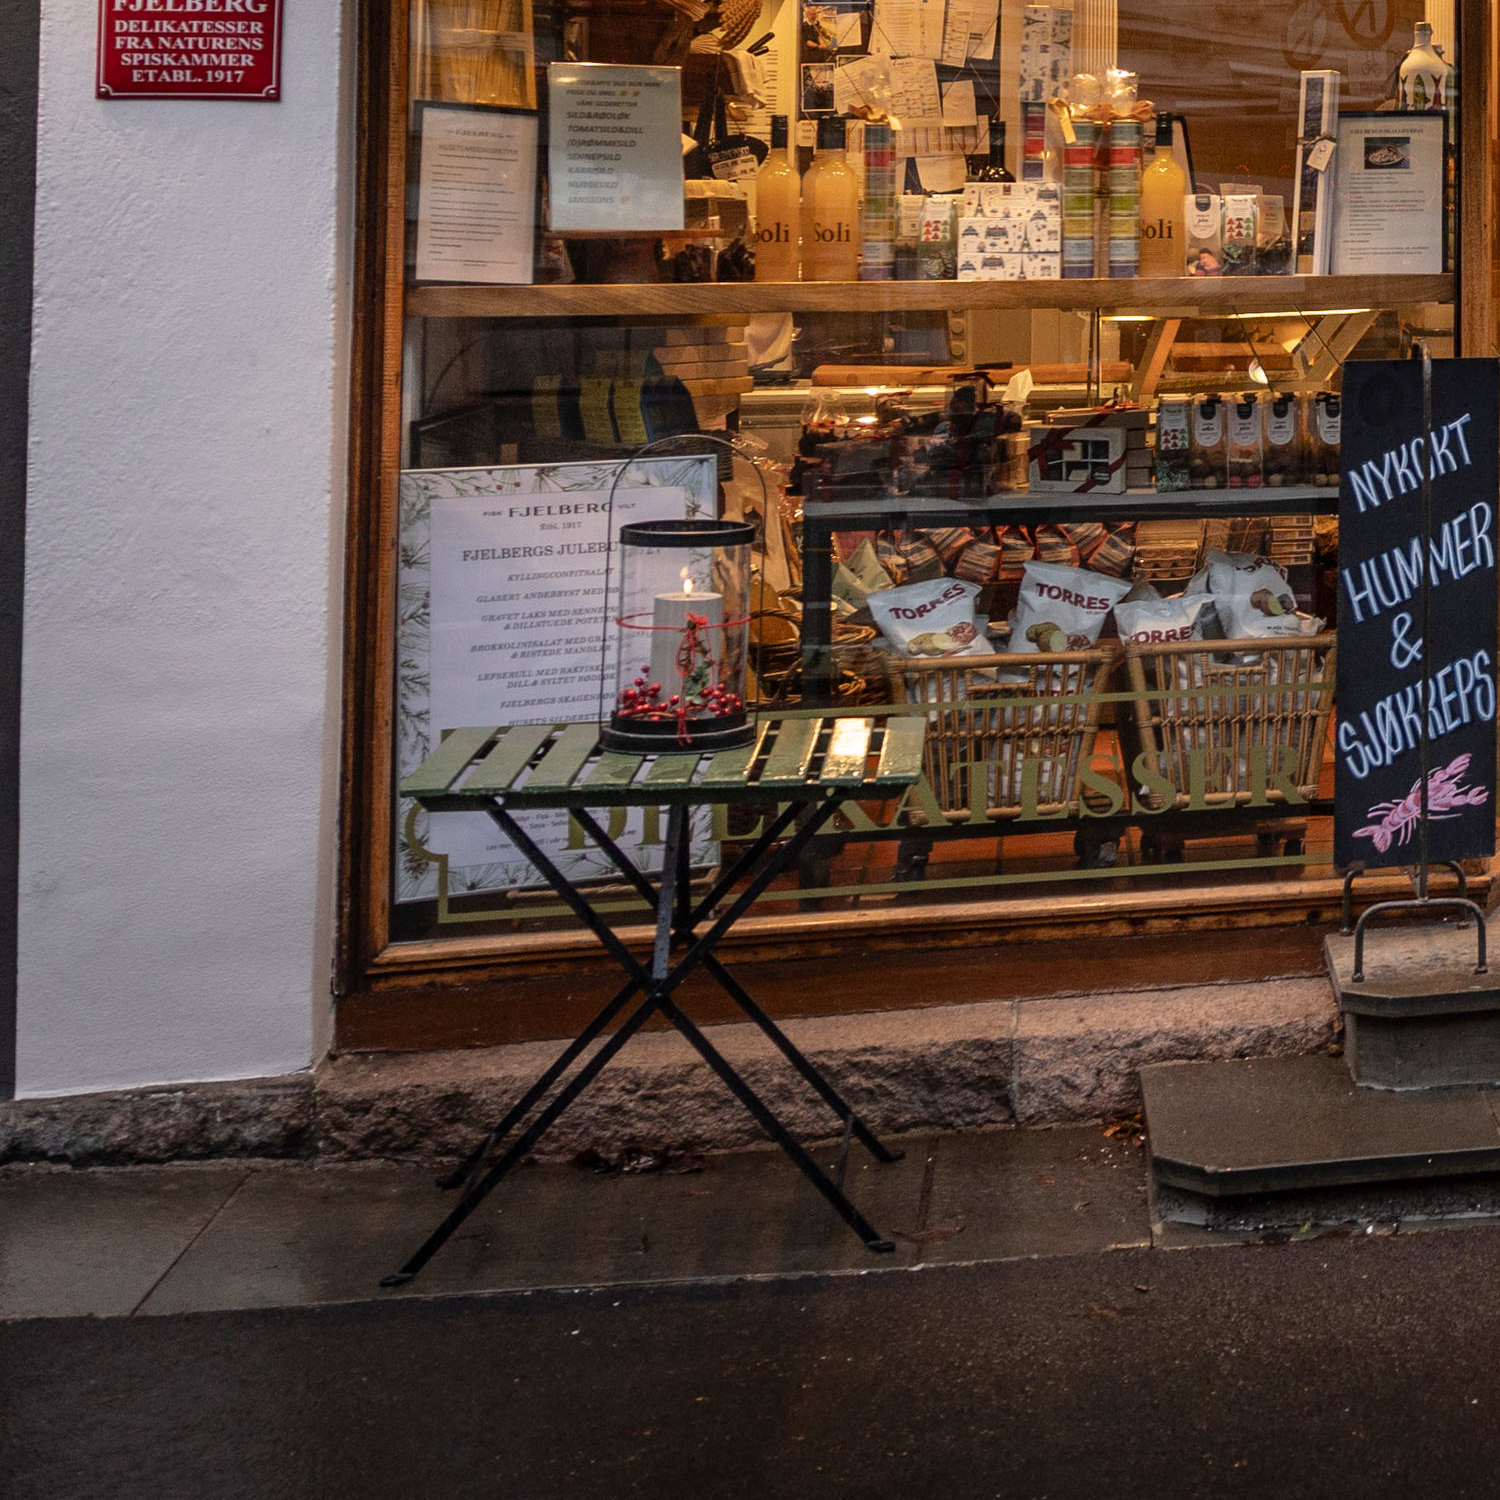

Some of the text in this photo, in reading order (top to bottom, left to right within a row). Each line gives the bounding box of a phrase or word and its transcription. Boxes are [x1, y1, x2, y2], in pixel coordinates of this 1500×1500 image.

[114, 19, 265, 35] DELIKATESSER
[115, 36, 264, 51] FRA NATURENS
[120, 53, 256, 67] SPISKAMMER
[131, 69, 246, 83] ETABL. 1917
[462, 544, 554, 563] FJELBERGS
[1341, 500, 1496, 625] HUMMER
[1035, 582, 1110, 611] TORRES
[1389, 611, 1423, 670] &
[559, 743, 1311, 850] DELKATESSER
